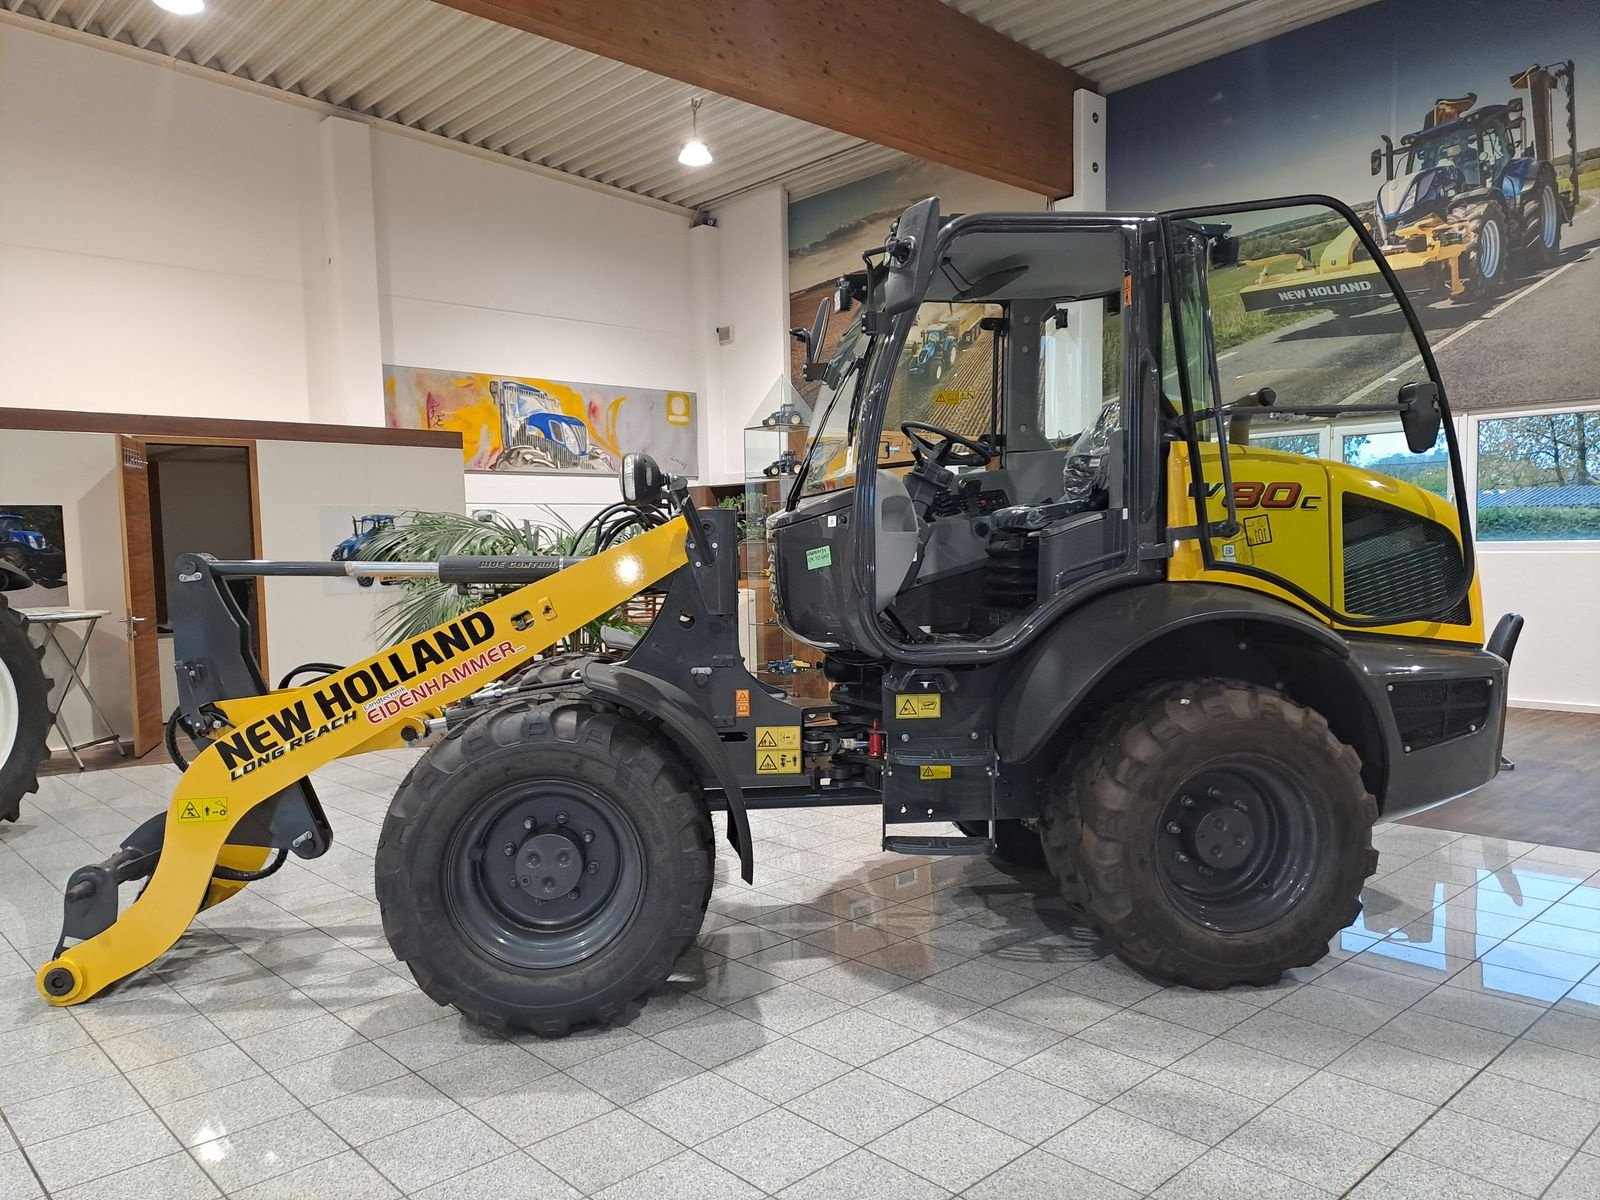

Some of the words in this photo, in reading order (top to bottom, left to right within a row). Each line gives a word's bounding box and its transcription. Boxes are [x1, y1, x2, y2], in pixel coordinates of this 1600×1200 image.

[1278, 289, 1306, 301] NEW
[1308, 280, 1372, 297] HOLLAND
[479, 561, 506, 569] RIDE
[508, 561, 558, 569] CONTROL
[214, 700, 312, 771] NEW
[313, 610, 496, 720] HOLLAND
[363, 686, 407, 712] Landtechnik
[366, 640, 517, 724] EIDENHAMMER
[230, 745, 285, 782] LONG
[289, 710, 358, 751] REACH
